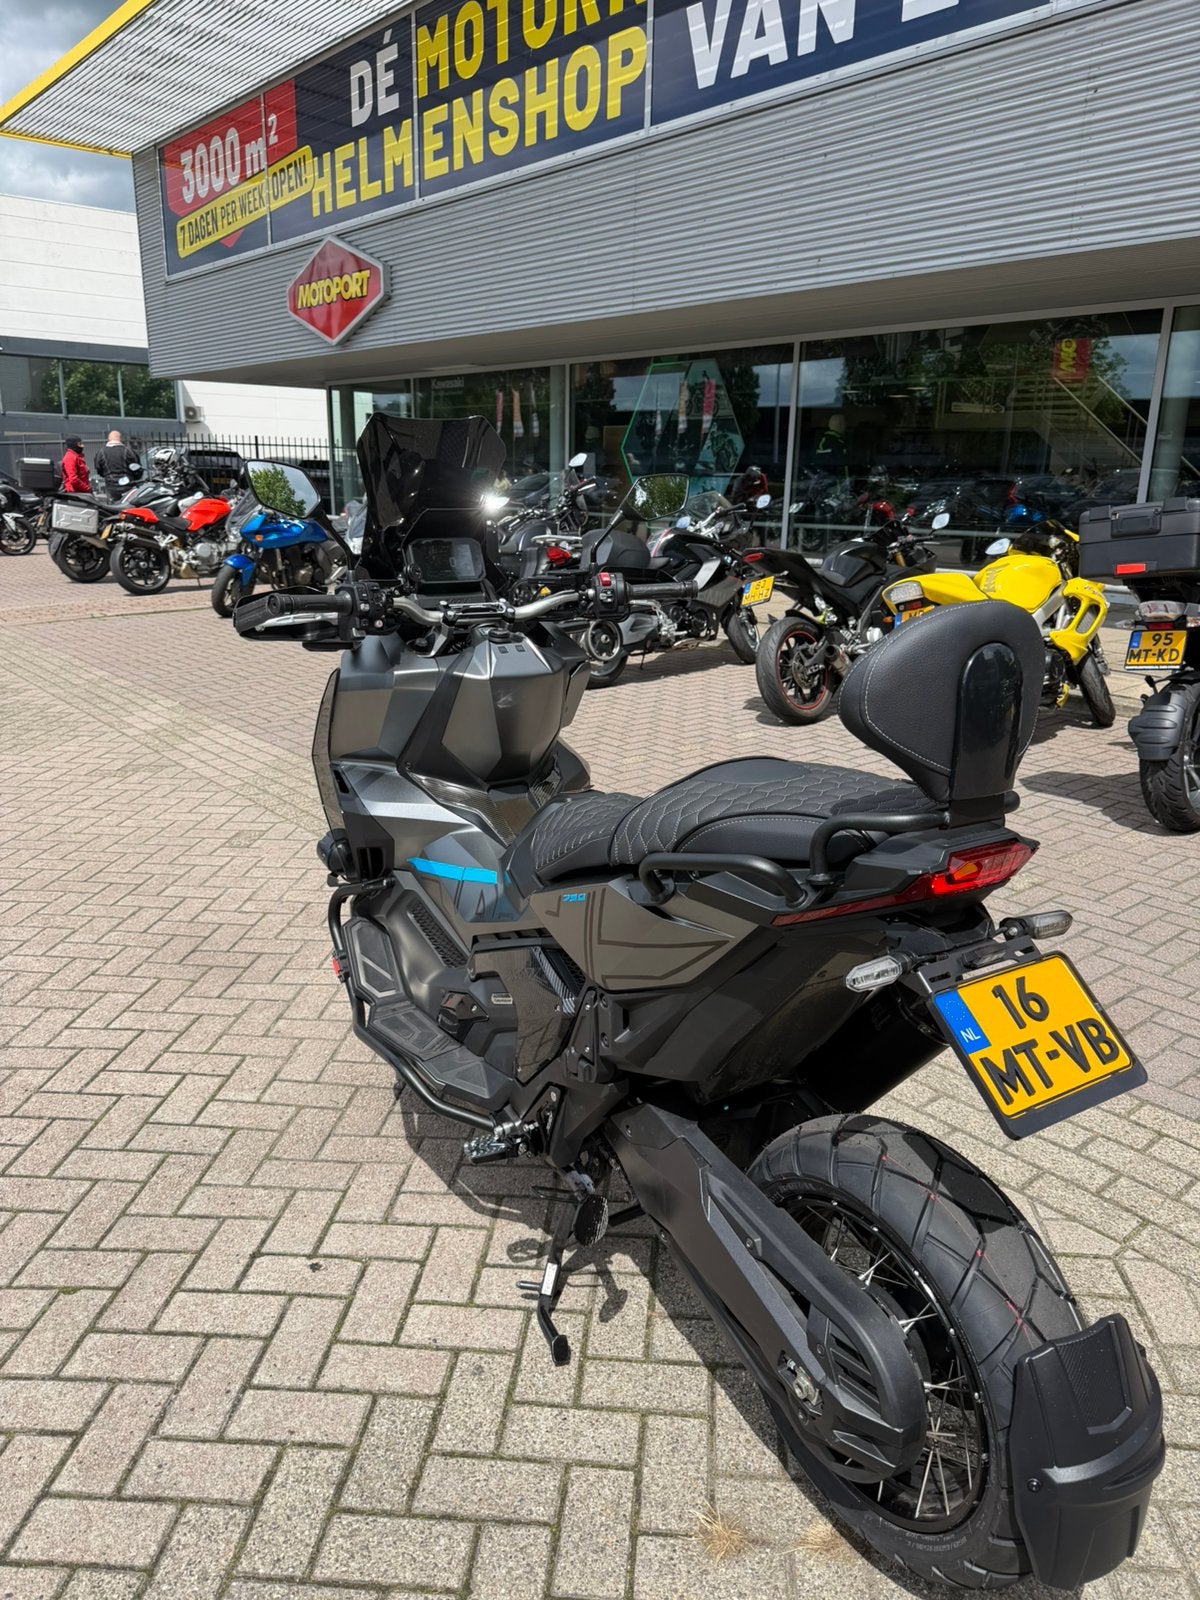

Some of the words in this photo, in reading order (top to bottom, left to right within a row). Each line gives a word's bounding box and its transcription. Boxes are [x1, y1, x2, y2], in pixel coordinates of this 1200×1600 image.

[350, 29, 400, 128] DÉ
[686, 0, 856, 89] VAN
[311, 26, 648, 218] HELMENSHOP
[179, 225, 186, 251] 7
[188, 207, 219, 247] DAGEN
[220, 198, 238, 230] PER
[238, 182, 266, 219] WEEK
[271, 154, 308, 201] OPEN!
[180, 127, 242, 204] 3000
[297, 269, 371, 310] MOTOPORT
[1128, 648, 1180, 663] MT-KD
[1152, 633, 1174, 646] 95
[960, 1027, 981, 1043] NL
[991, 976, 1050, 1029] 16
[979, 1017, 1120, 1106] MT-VB
